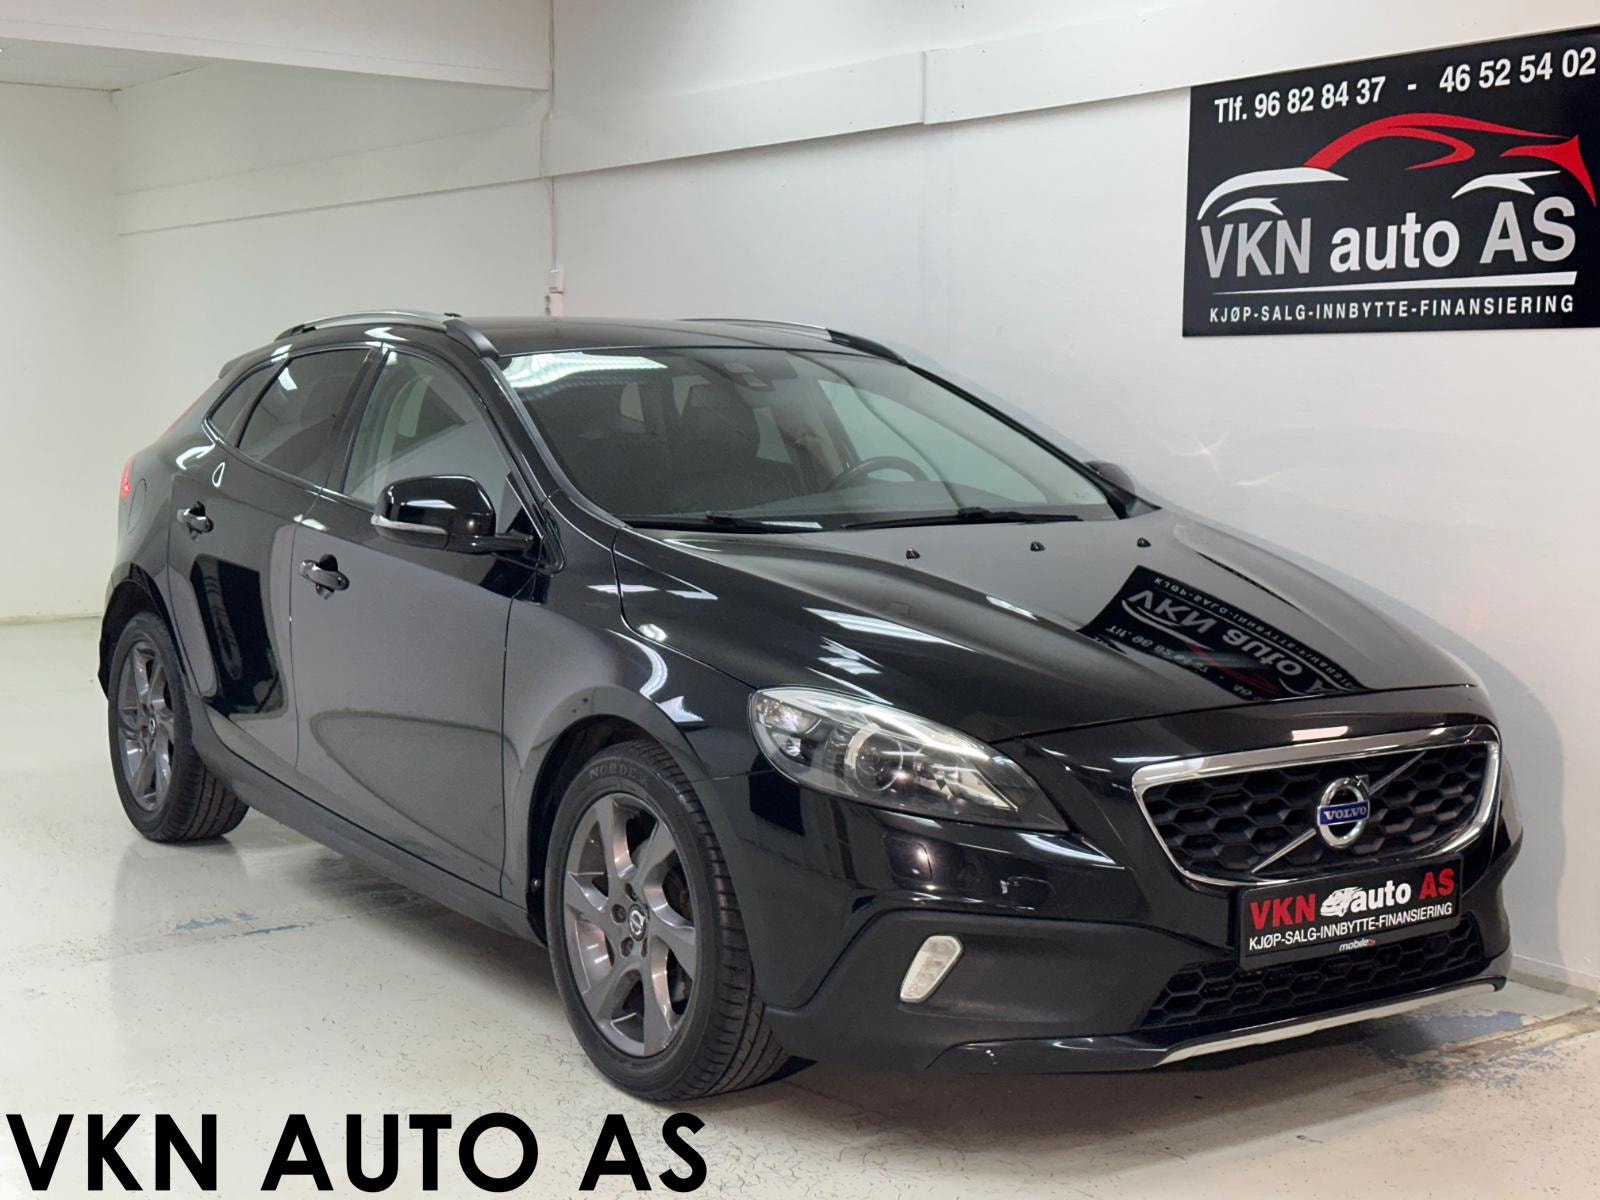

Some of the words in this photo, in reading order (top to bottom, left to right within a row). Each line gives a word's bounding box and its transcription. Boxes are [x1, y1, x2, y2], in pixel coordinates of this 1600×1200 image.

[1213, 95, 1248, 124] Tlf.
[1254, 90, 1281, 119] 96
[1286, 86, 1315, 114] 82
[1320, 80, 1350, 110] 84
[1355, 75, 1386, 105] 37
[1439, 63, 1471, 93] 46
[1478, 58, 1511, 89] 52
[1519, 51, 1553, 84] 54
[1561, 46, 1597, 78] 02
[1200, 217, 1312, 279] VKN
[1329, 211, 1460, 273] auto
[1479, 196, 1576, 264] AS
[1209, 294, 1574, 323] KJØP-SALG-INNBYTTE-FINANSIERING
[1323, 805, 1368, 821] VOLVO
[1249, 893, 1317, 930] VKN
[1350, 879, 1412, 913] auto
[1418, 867, 1456, 900] AS
[1249, 901, 1453, 951] KJØP-SALG-INNBYTTE-FINANSIERING
